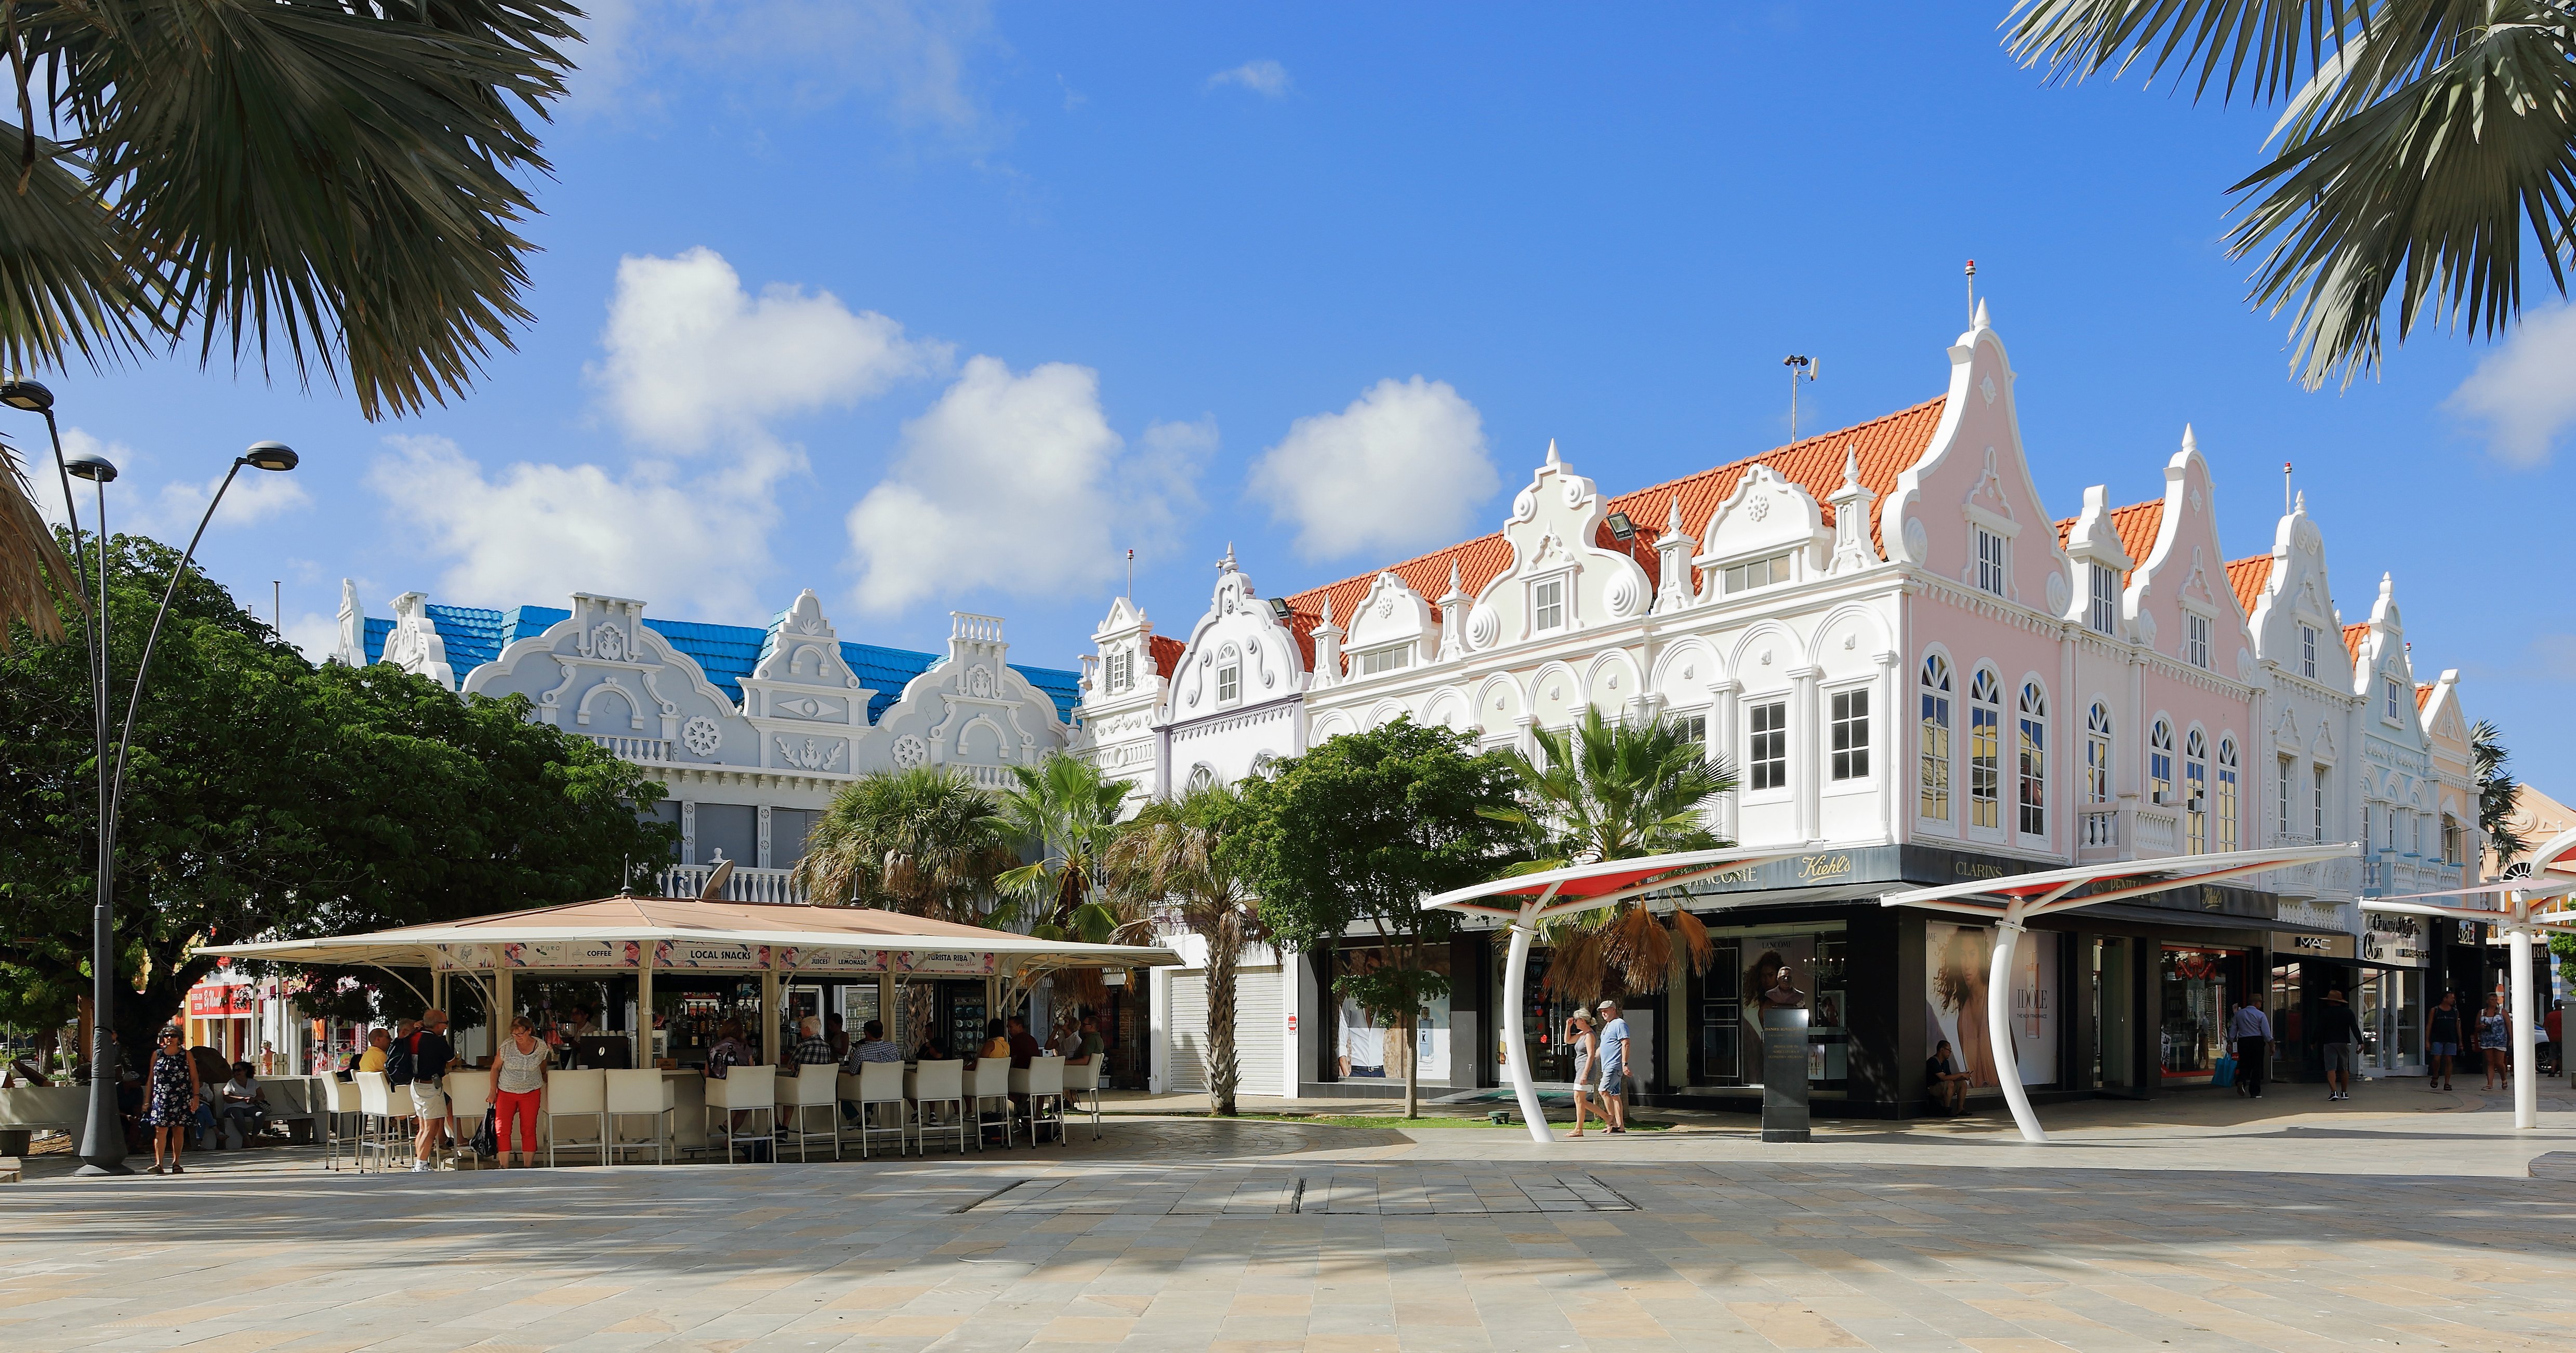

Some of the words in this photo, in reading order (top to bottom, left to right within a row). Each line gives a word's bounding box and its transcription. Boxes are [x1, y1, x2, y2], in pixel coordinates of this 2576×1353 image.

[1798, 855, 1851, 879] Kiehl's
[1956, 861, 2003, 878] CLARINS
[2300, 936, 2331, 950] MAC
[691, 950, 718, 959] LOCAL
[721, 951, 751, 960] SNACKS
[842, 950, 863, 960] Fresh
[2017, 984, 2048, 1009] IDÔLE
